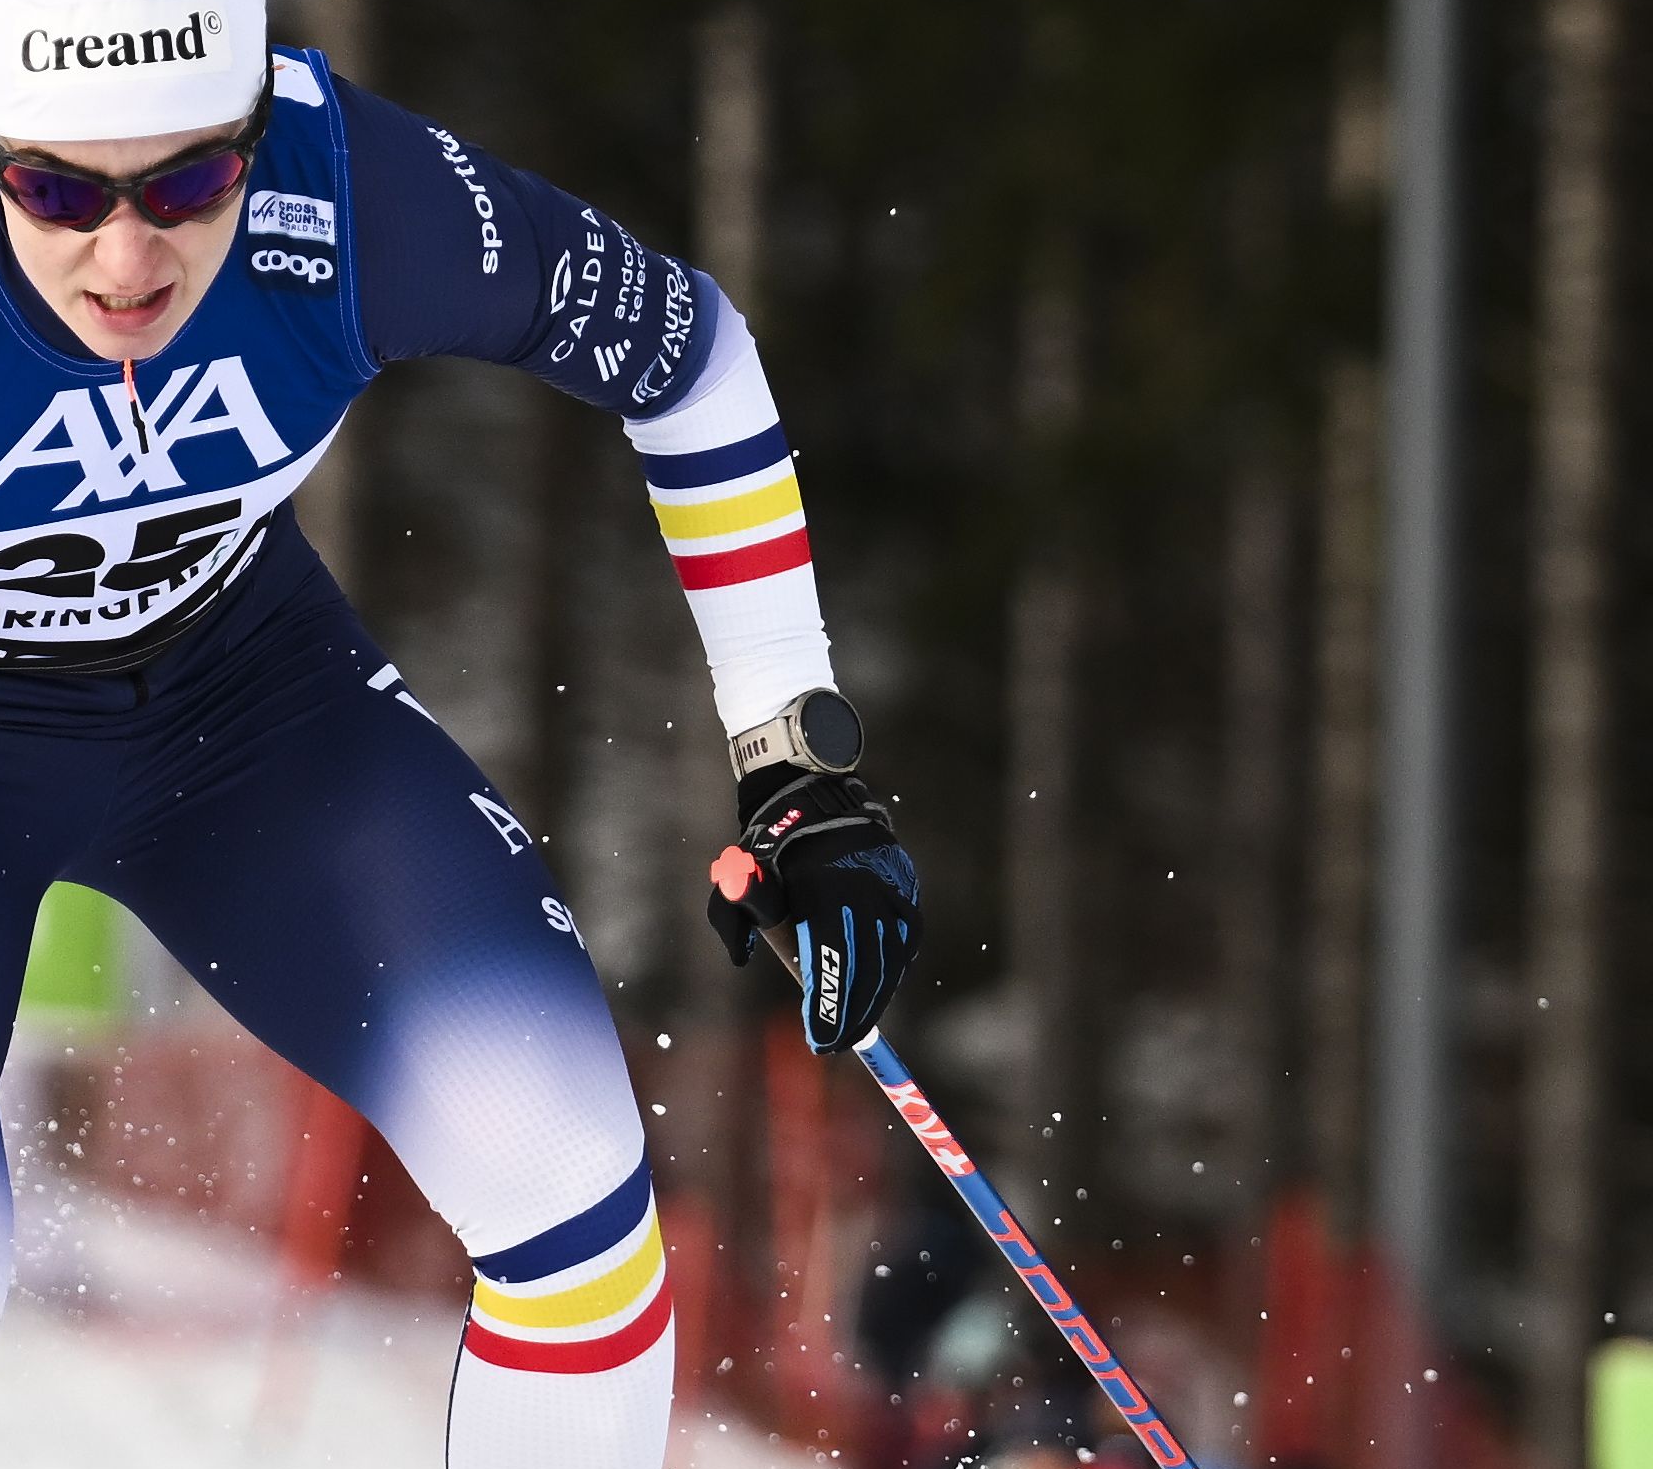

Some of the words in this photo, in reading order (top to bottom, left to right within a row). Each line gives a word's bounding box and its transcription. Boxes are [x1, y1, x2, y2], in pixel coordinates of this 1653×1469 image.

[278, 200, 318, 215] CROSS
[278, 211, 332, 229] COUNTRY
[251, 249, 334, 284] coop
[550, 207, 604, 362] CALDEA
[819, 944, 840, 1025] KV+
[882, 1080, 976, 1177] KV+
